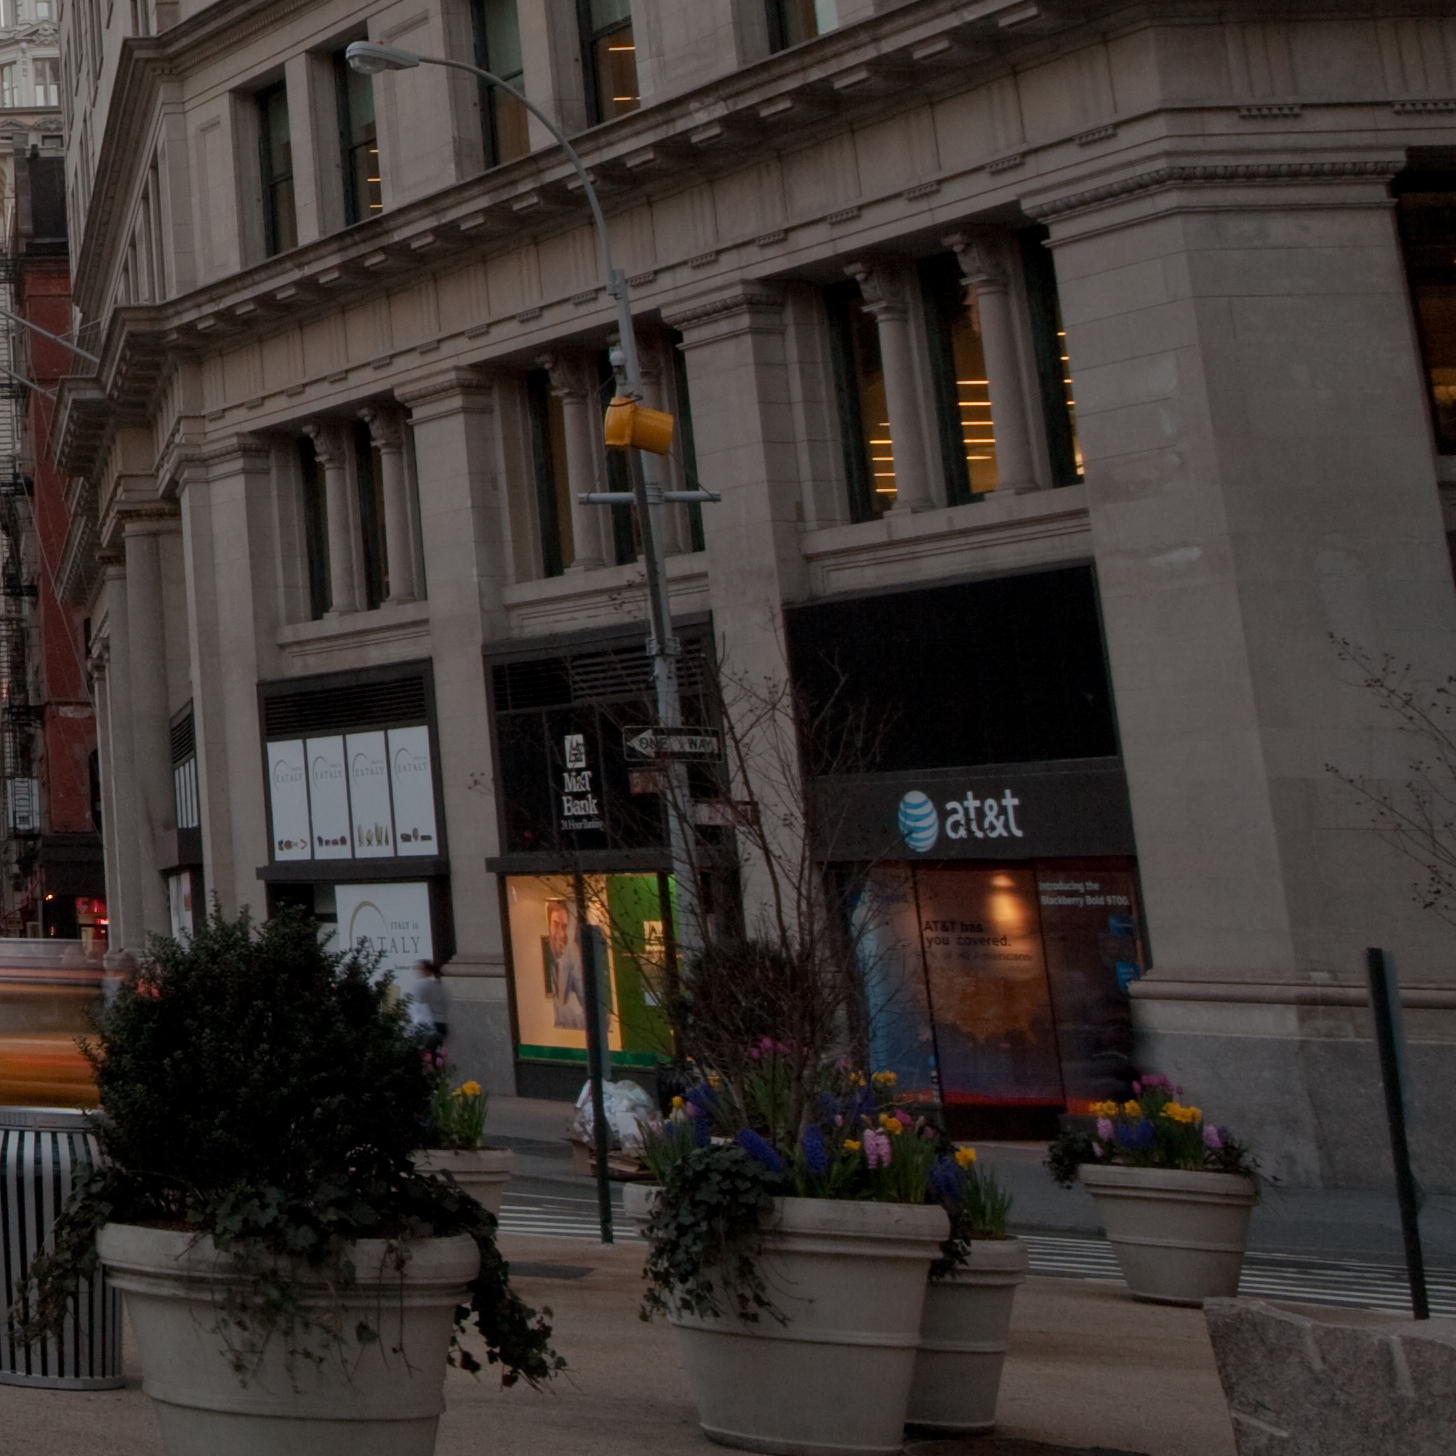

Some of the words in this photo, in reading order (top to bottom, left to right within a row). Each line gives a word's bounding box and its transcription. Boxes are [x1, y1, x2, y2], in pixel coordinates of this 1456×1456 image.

[355, 766, 385, 777] EATALY
[397, 762, 428, 773] EATALY
[276, 772, 303, 783] EATALY
[314, 770, 343, 780] EATALY
[562, 771, 592, 793] M&T
[562, 793, 600, 816] Bank
[945, 789, 1024, 840] at&t
[1040, 895, 1084, 908] Blackberry
[1085, 895, 1105, 906] Bold
[390, 921, 410, 930] ITALY
[924, 920, 956, 932] AT&T
[960, 921, 984, 933] has
[925, 935, 950, 948] you
[957, 935, 1012, 947] covered.
